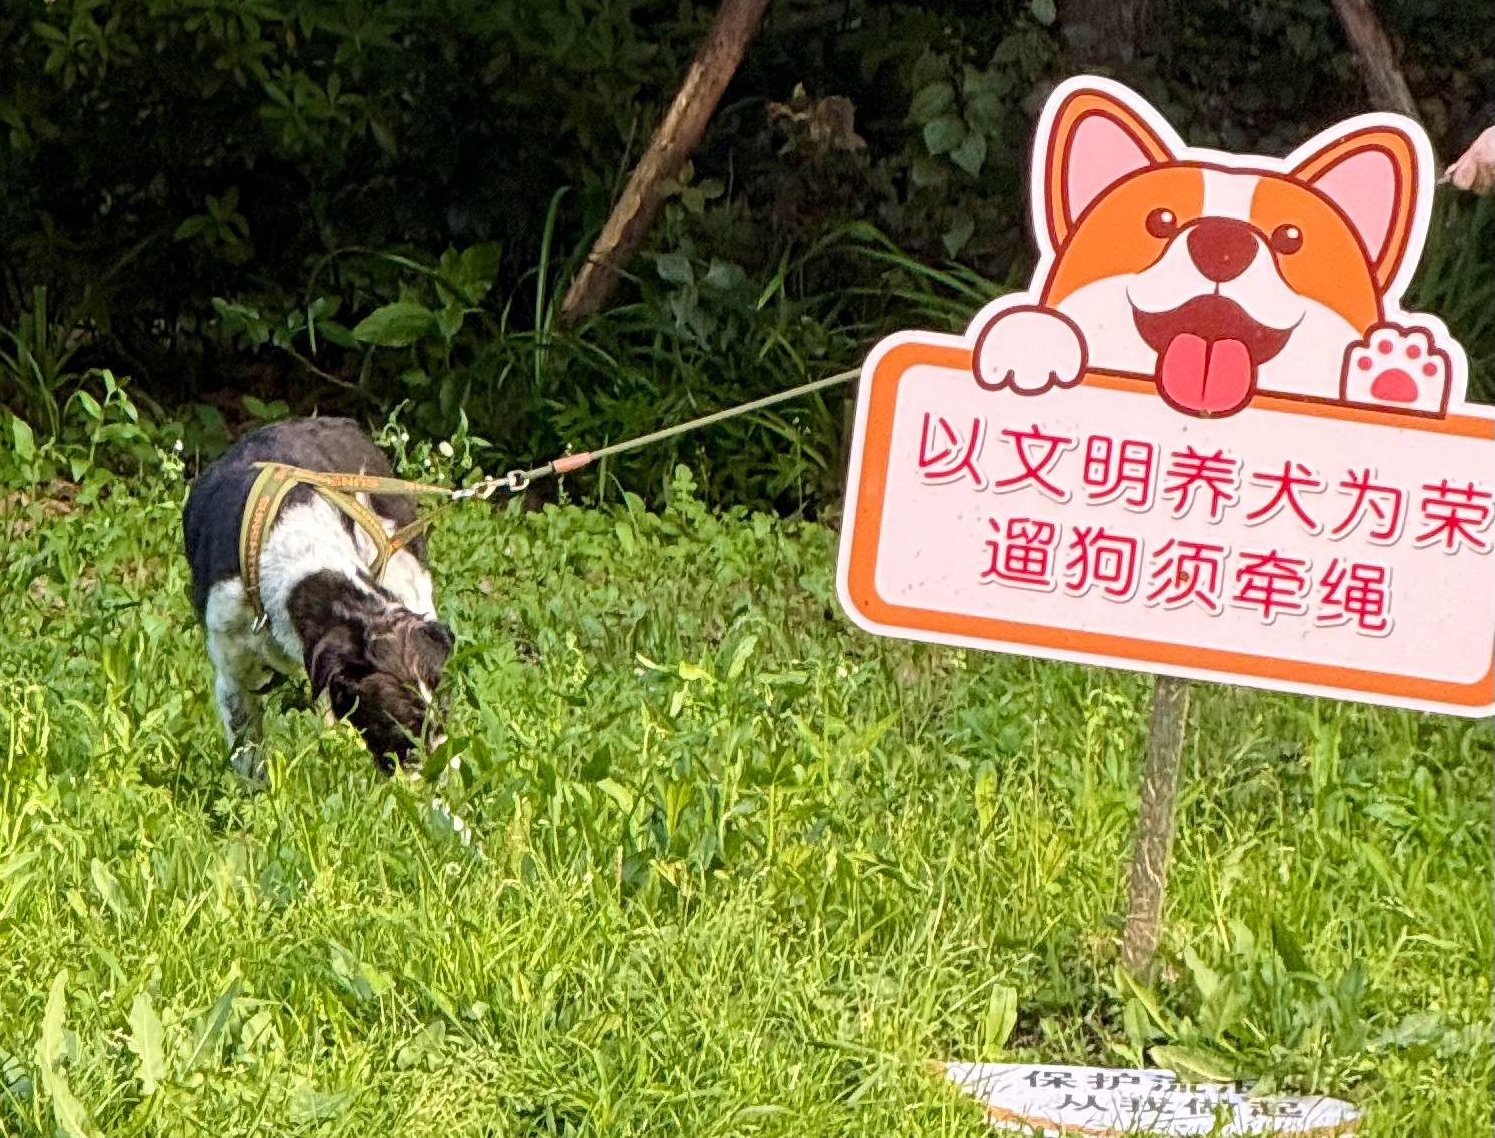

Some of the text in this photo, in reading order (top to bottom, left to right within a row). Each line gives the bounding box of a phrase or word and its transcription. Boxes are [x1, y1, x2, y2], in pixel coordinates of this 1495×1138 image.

[917, 411, 1494, 551] 以文明养犬为荣
[980, 517, 1391, 632] 遛狗须牵绳
